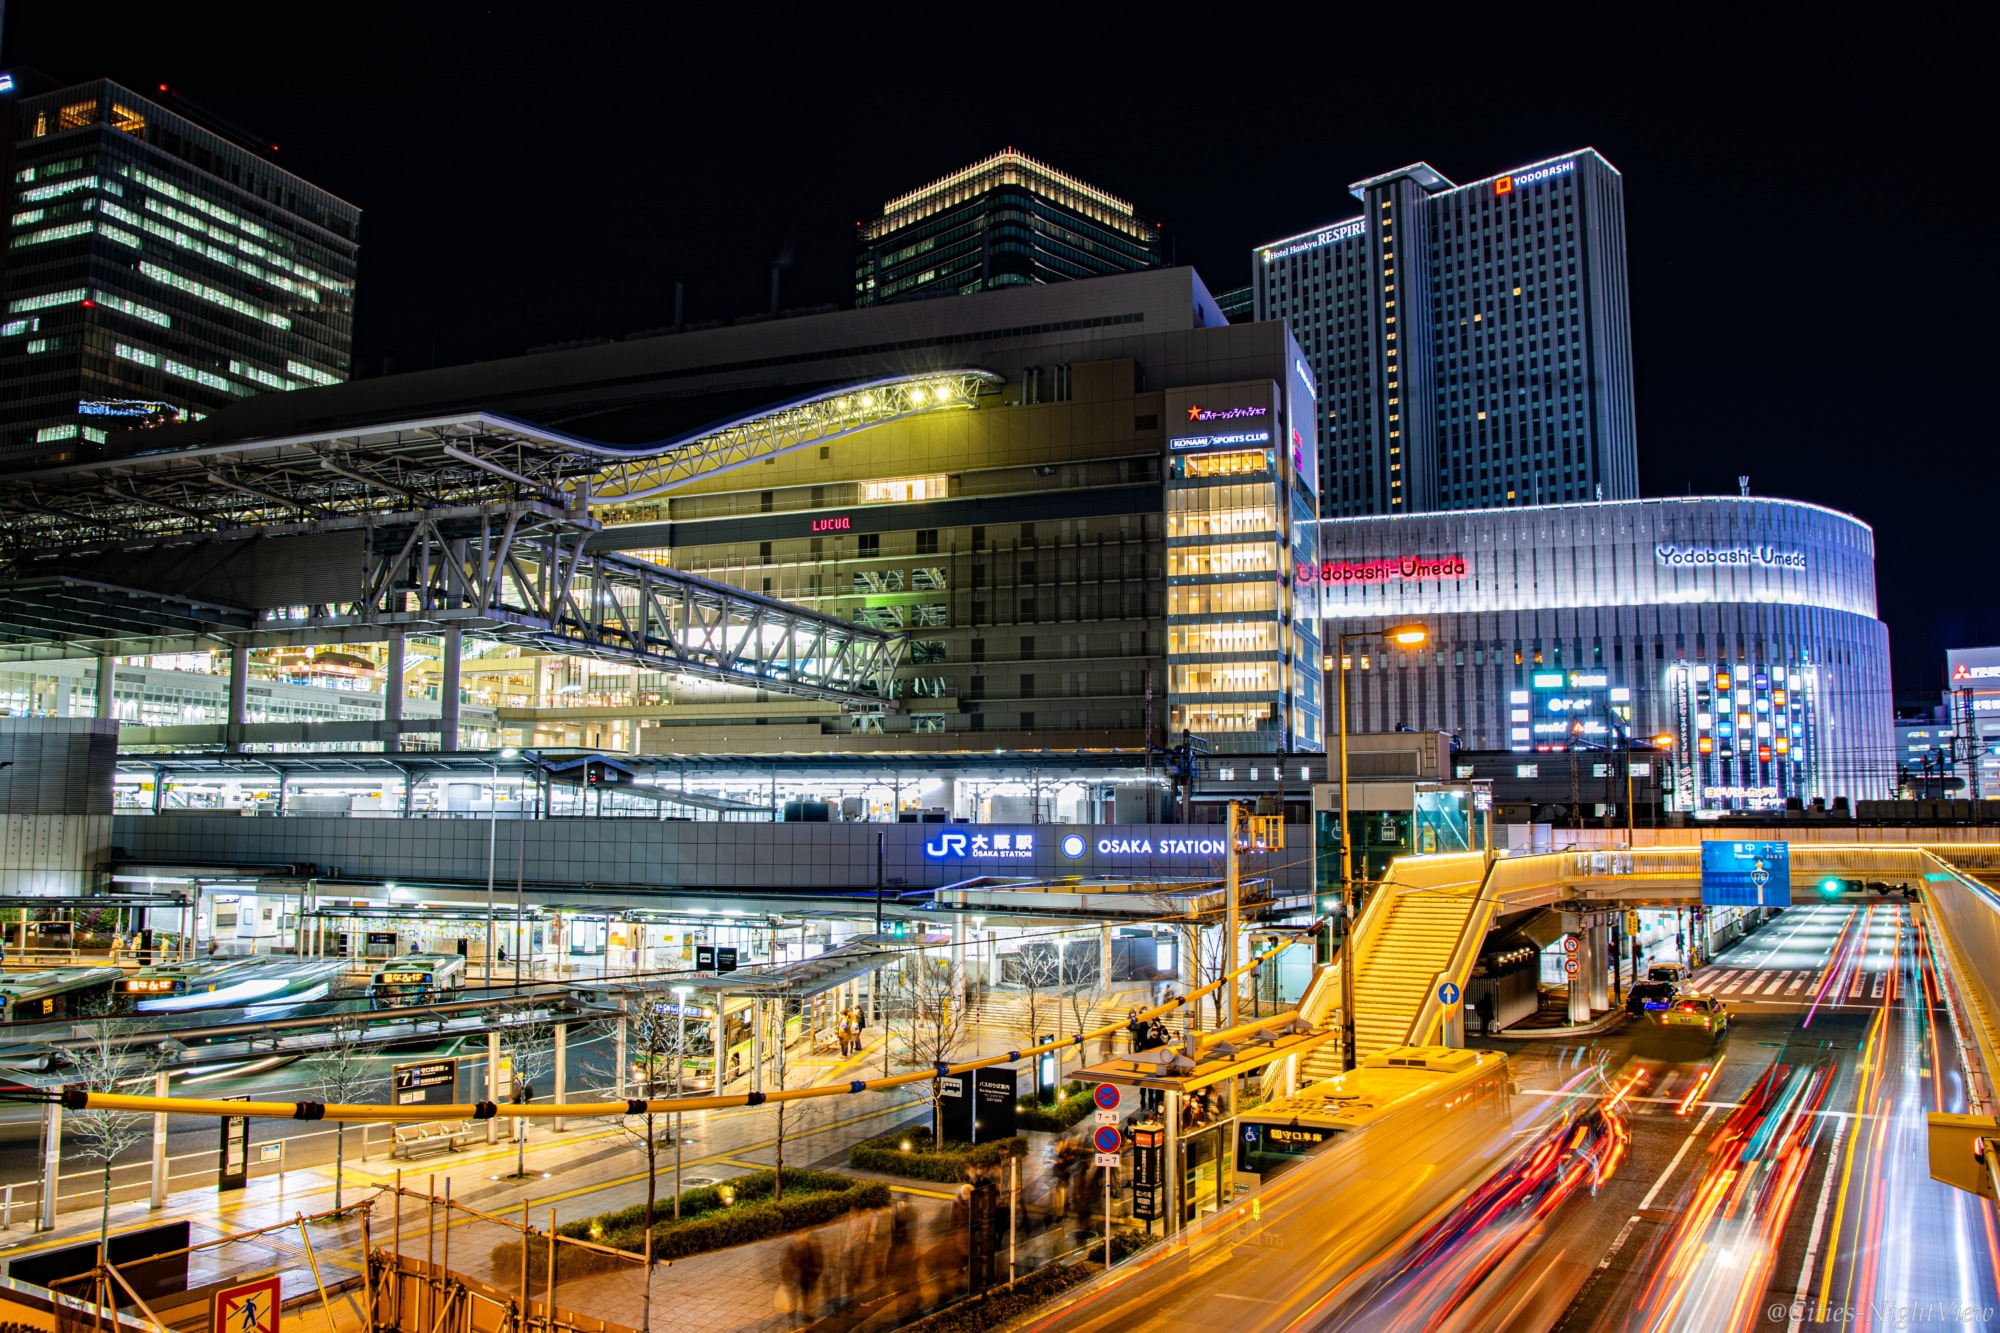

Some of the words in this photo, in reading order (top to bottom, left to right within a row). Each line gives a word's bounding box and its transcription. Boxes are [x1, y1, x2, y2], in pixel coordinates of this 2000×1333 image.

[1514, 161, 1574, 185] YODOBASHI
[1270, 248, 1288, 259] Hotel
[1290, 241, 1318, 254] Hankyu
[1174, 438, 1208, 447] KONAMI
[1212, 435, 1245, 445] SPORTS
[1245, 432, 1269, 442] CLUB
[1658, 547, 1807, 567] Yodobashi-Umeda
[927, 834, 967, 856] JR
[971, 834, 1033, 850] 大阪駅
[1098, 839, 1152, 854] OSAKA
[1159, 839, 1225, 854] STATION
[1763, 843, 1785, 853] 十三
[1000, 850, 1032, 858] STATION
[1754, 873, 1766, 881] 176
[392, 973, 423, 983] なんば
[139, 981, 172, 991] なんば
[400, 1073, 410, 1086] 7
